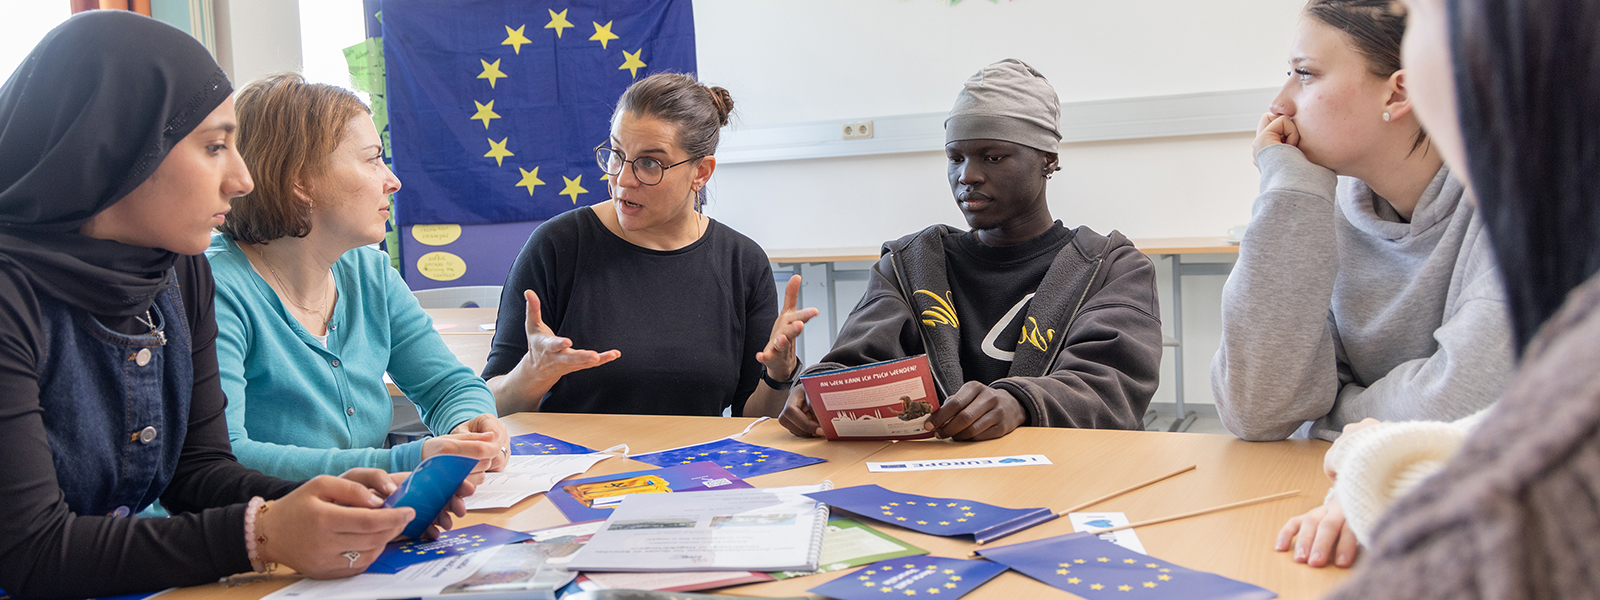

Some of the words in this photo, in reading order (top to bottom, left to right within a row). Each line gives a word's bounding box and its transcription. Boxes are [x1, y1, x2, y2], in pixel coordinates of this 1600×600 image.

[844, 376, 861, 384] KANN
[872, 371, 889, 379] MICH
[889, 365, 917, 376] WENDEN?
[912, 459, 993, 468] EUROPE
